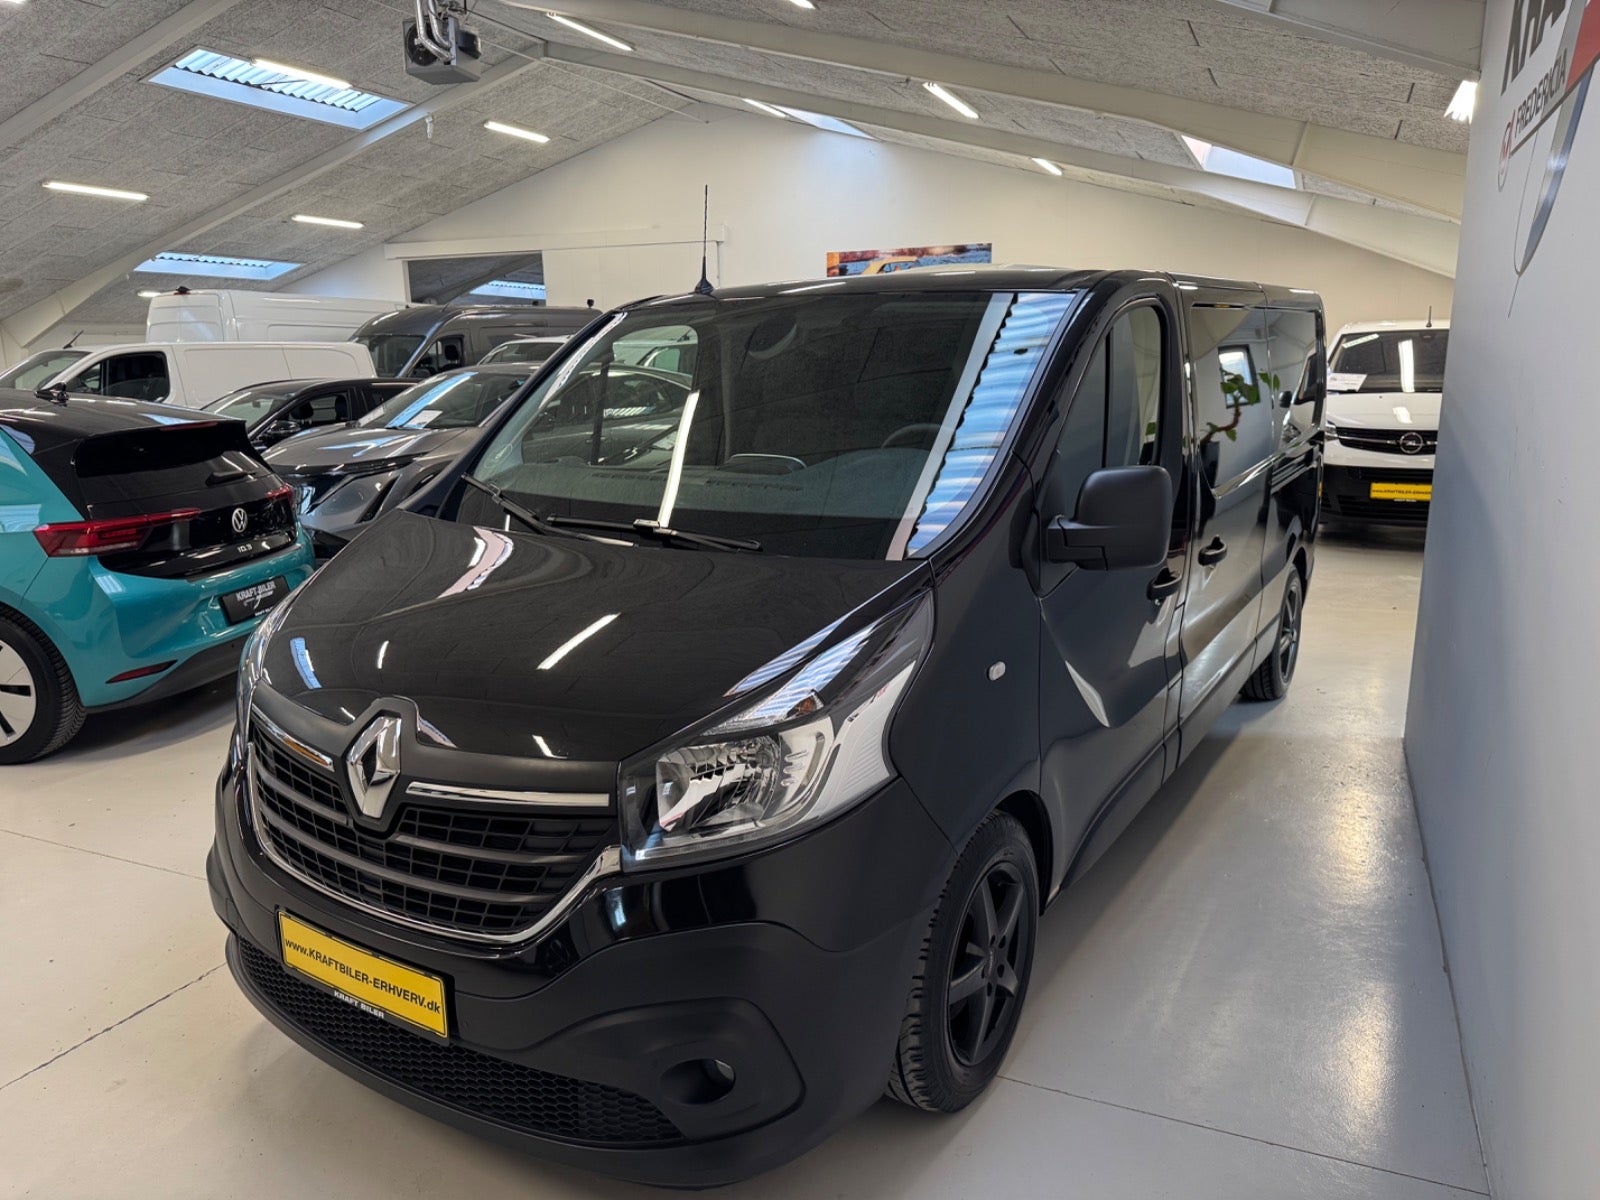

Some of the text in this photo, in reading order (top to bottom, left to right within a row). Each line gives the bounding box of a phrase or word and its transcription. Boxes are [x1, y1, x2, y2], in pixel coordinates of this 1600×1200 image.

[285, 939, 441, 1014] www.KRAFTBILER-ERHVERV.dk
[333, 990, 385, 1019] KRAFT BILER
